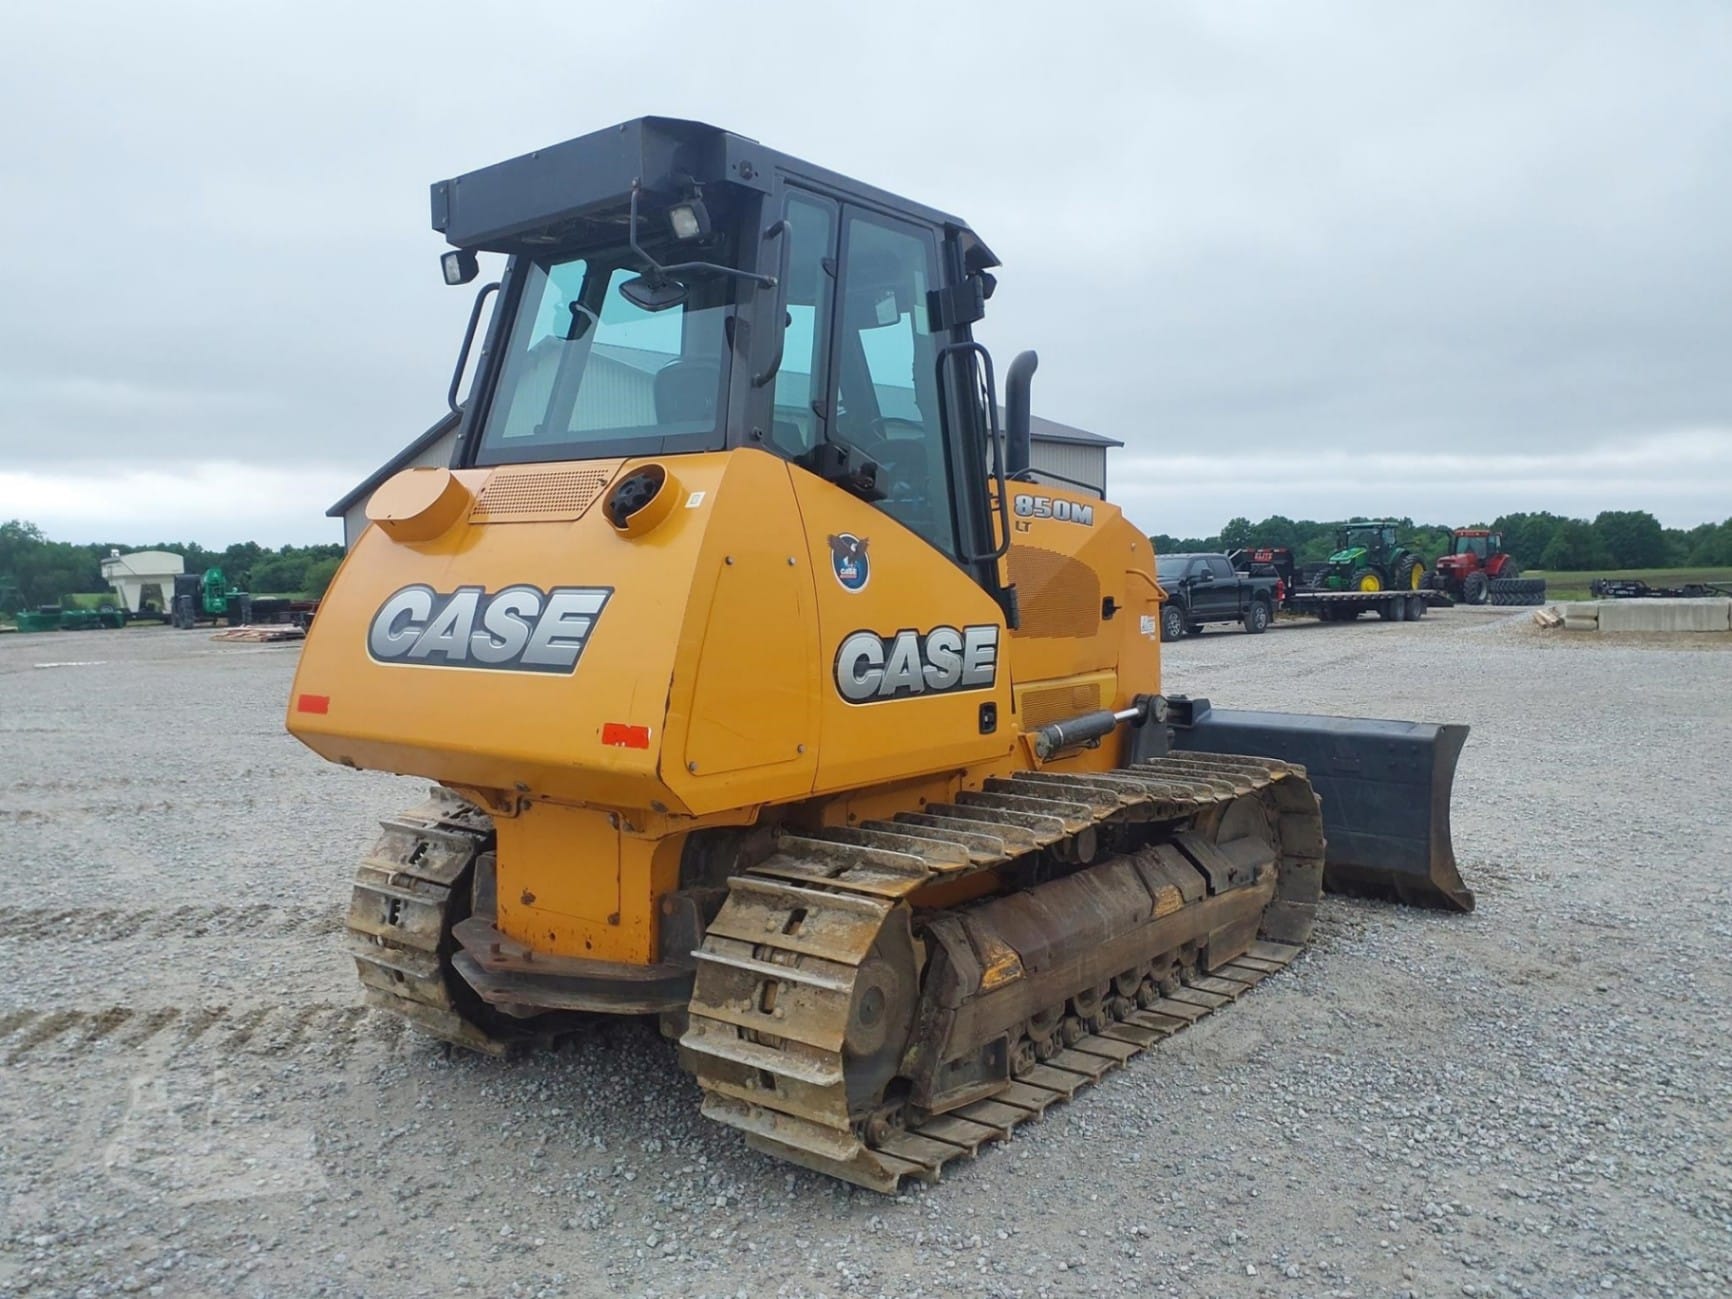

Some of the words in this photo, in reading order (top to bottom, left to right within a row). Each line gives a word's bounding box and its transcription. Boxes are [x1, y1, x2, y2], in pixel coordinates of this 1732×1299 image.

[1014, 494, 1093, 526] 850M
[1015, 520, 1032, 533] LT
[369, 583, 614, 672] CASE
[834, 625, 999, 703] CASE
